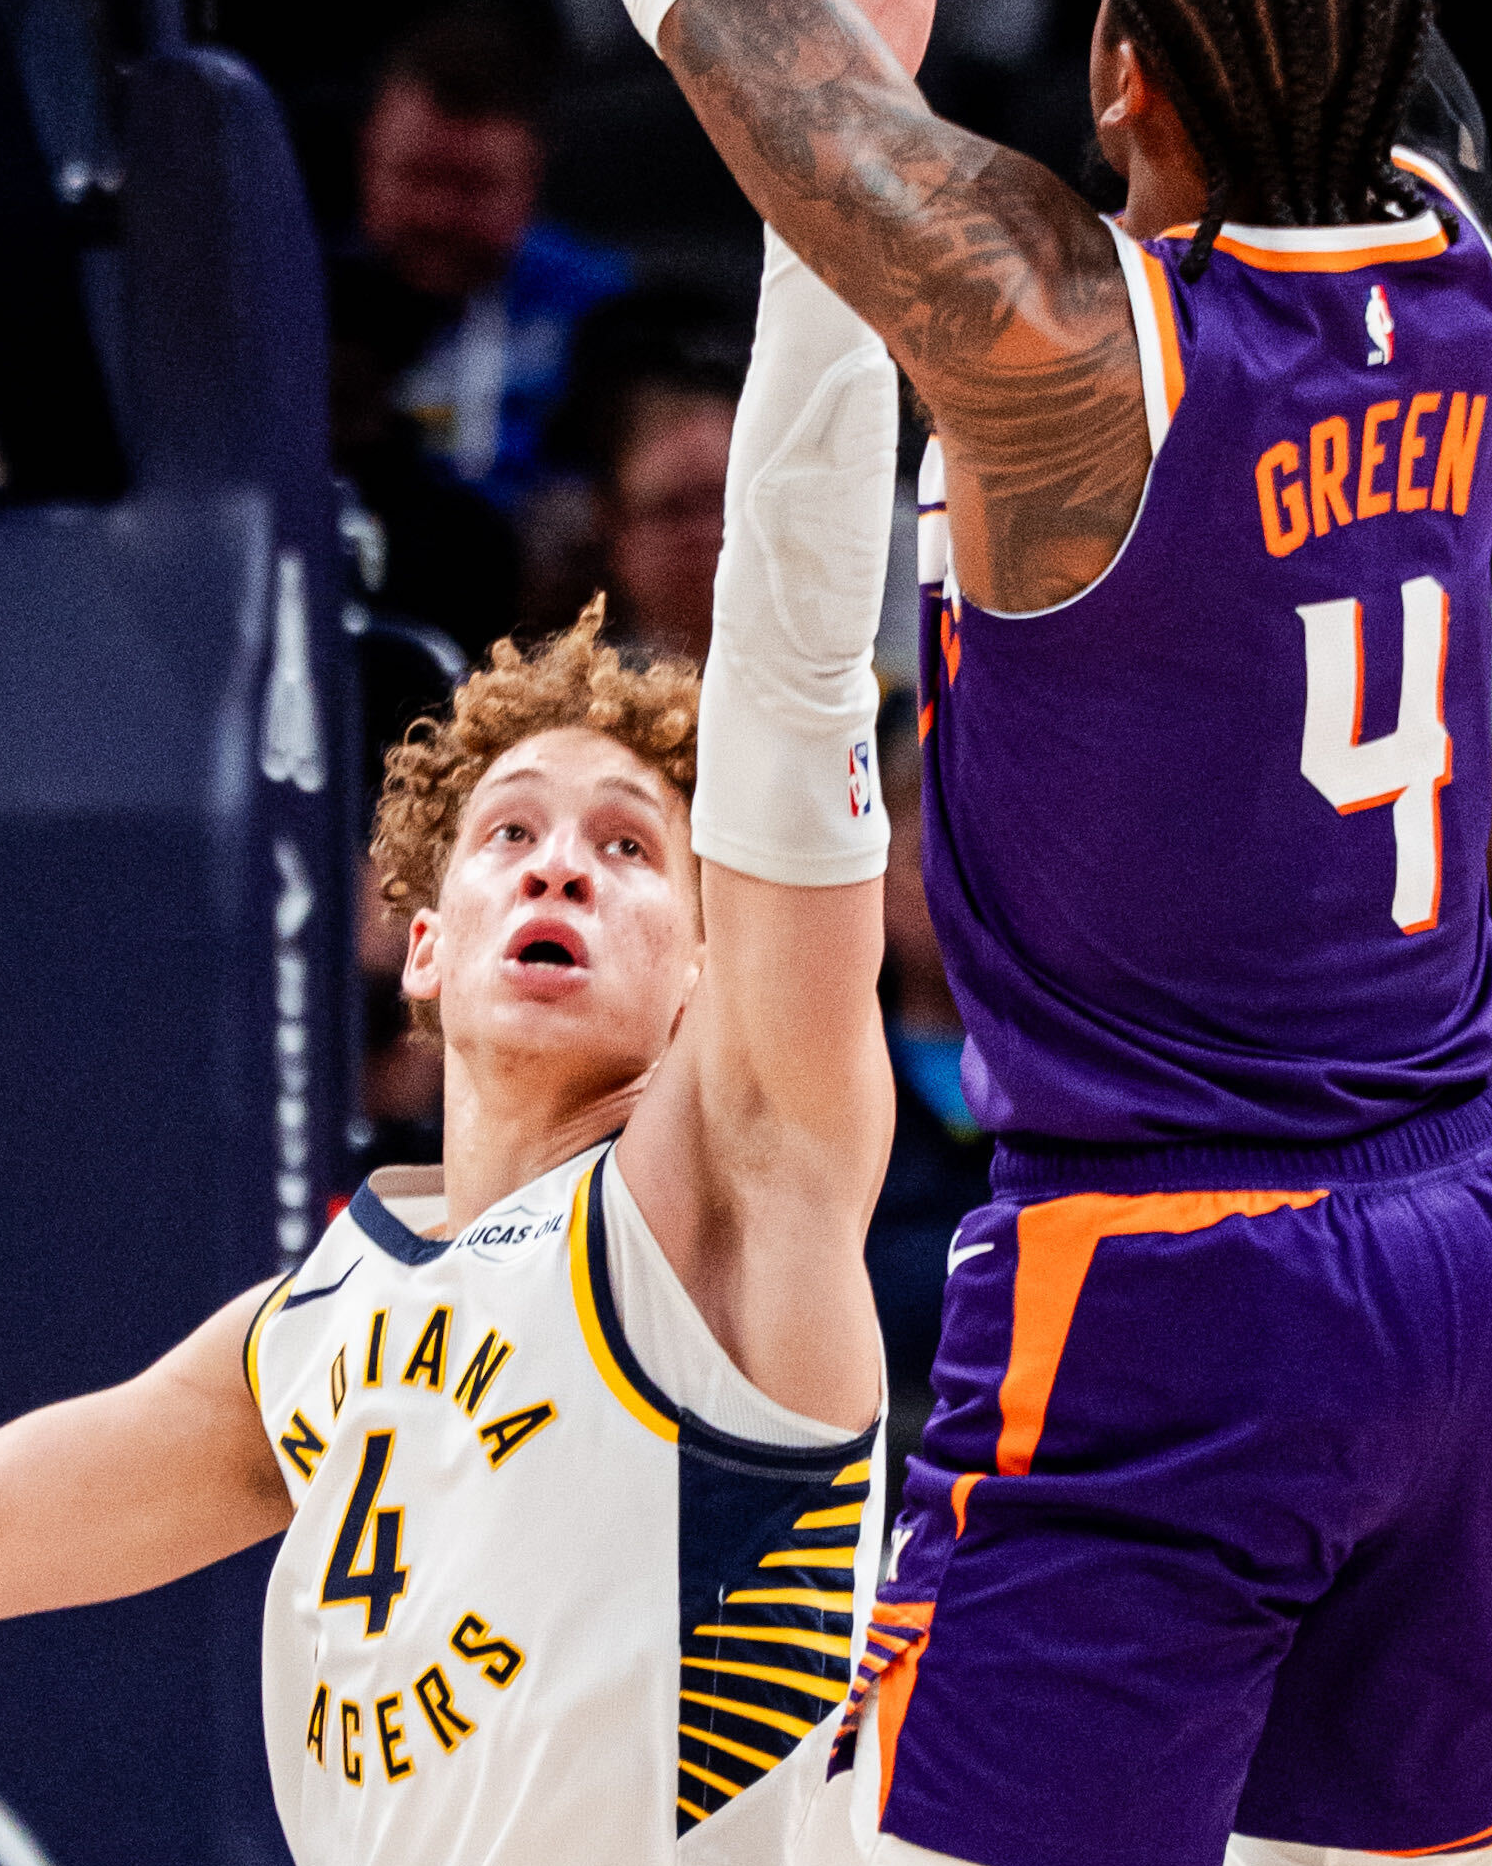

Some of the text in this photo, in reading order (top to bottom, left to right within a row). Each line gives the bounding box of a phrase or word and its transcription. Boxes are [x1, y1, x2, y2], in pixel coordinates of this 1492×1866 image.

[1254, 391, 1488, 560] GREEN
[1295, 575, 1453, 935] 4
[455, 1224, 533, 1251] LUCAS
[534, 1212, 565, 1240] OIL
[278, 1305, 560, 1483] NDIANA
[319, 1429, 412, 1638] 4
[306, 1611, 527, 1787] ACERS
